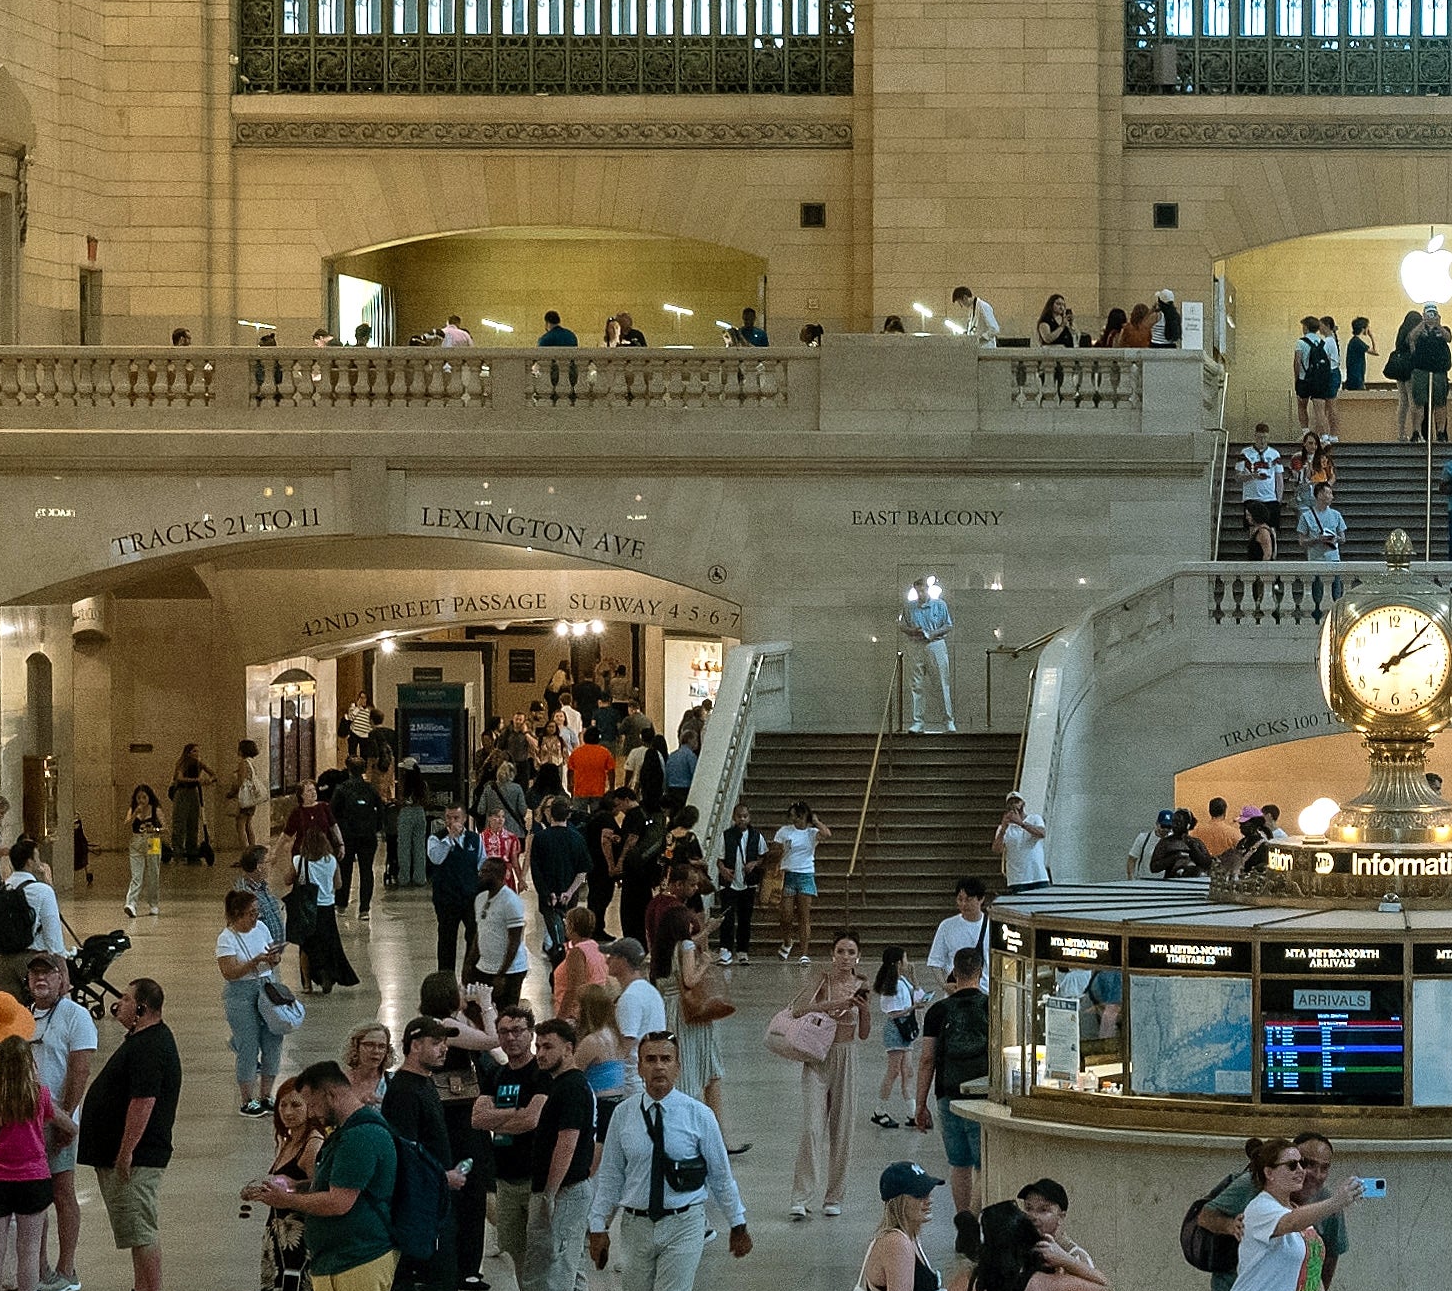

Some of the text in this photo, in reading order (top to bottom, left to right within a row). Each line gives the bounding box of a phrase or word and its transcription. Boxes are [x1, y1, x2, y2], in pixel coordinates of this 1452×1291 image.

[851, 509, 1004, 527] EAST BALCONY
[111, 507, 321, 556] TRACKS 21 TO 11
[421, 506, 646, 560] LEXINGTON AVE
[300, 593, 663, 638] 42ND STREET PASSAGE SUBWAY
[1389, 614, 1401, 628] 12
[1370, 620, 1380, 635] 11
[1358, 675, 1366, 690] 8
[1425, 673, 1434, 688] 4
[1371, 687, 1381, 702] 7
[1391, 691, 1400, 706] 6
[1409, 688, 1420, 703] 5
[1220, 713, 1321, 748] TRACKS 100
[1150, 944, 1232, 956] MTA METRO-NORTH
[1284, 948, 1380, 959] MTA METRO-NORTH
[1166, 954, 1216, 965] TIMETABLES
[1309, 958, 1356, 968] ARRIVALS
[1298, 994, 1366, 1007] ARRIVALS
